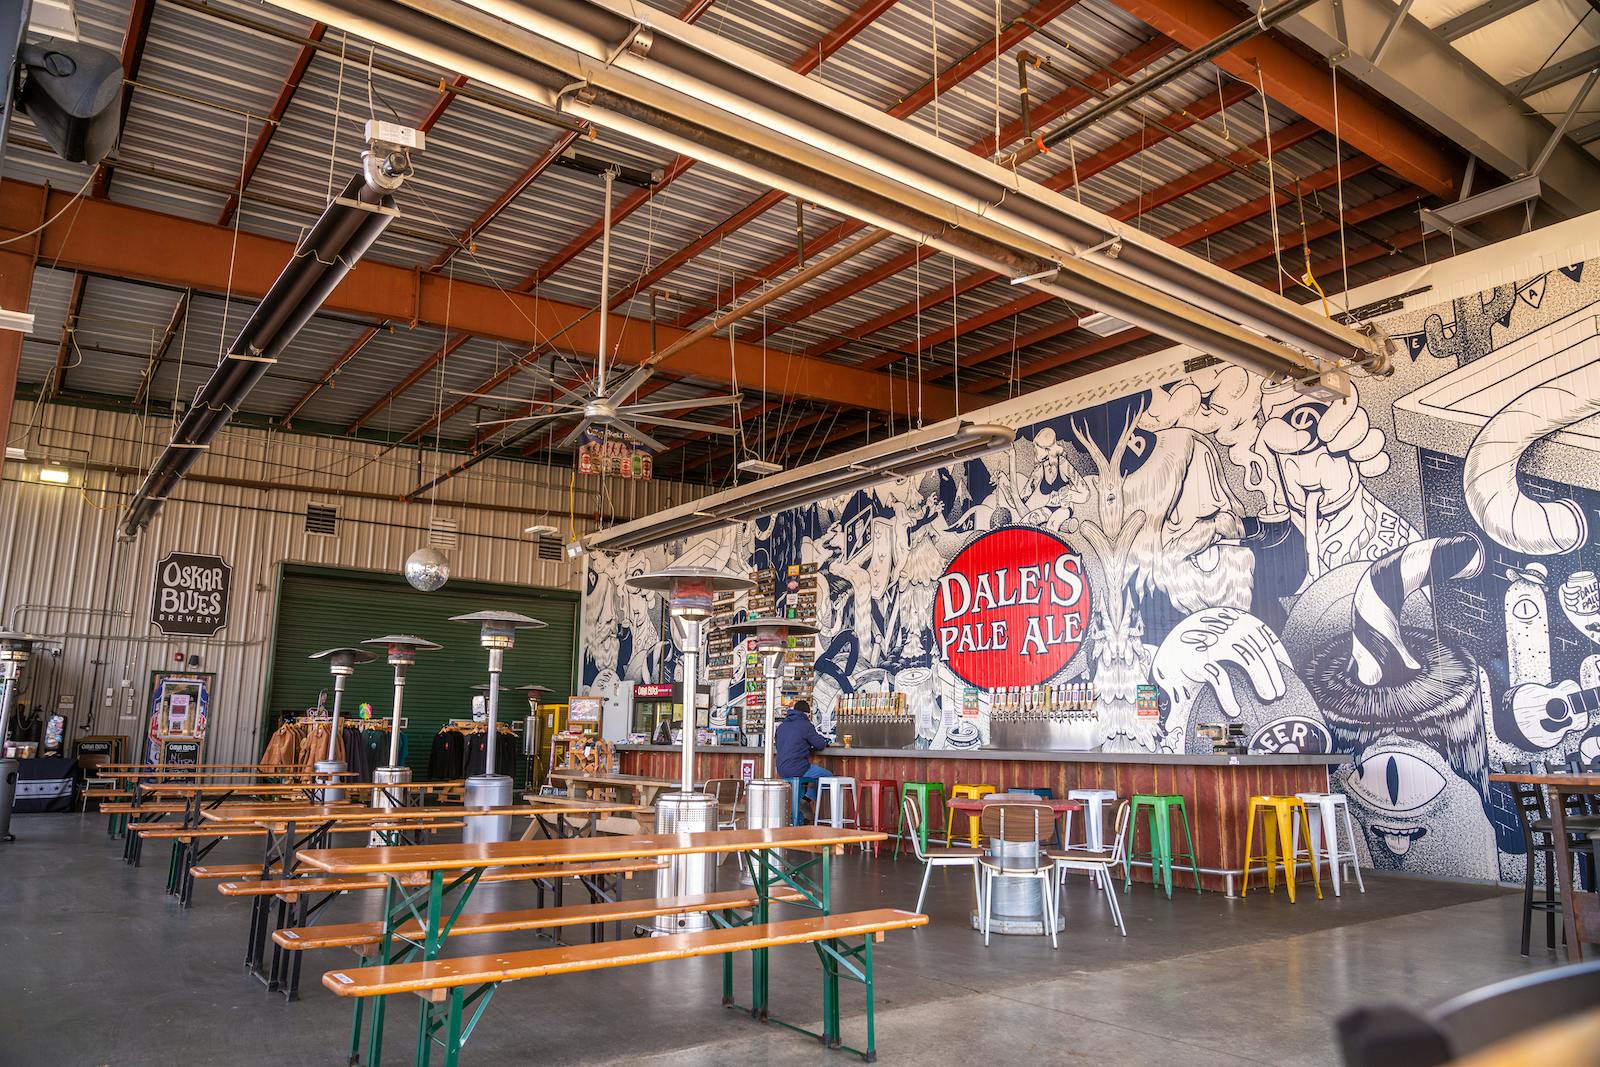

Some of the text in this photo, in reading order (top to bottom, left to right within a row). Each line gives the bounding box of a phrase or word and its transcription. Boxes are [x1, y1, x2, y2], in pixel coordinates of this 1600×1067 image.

[163, 561, 223, 591] OSKAR
[938, 552, 1083, 623] DALE'S
[160, 587, 221, 615] BLUES
[159, 614, 220, 624] BREWERY
[940, 611, 1083, 661] PALE ALE
[1256, 722, 1309, 754] EER
